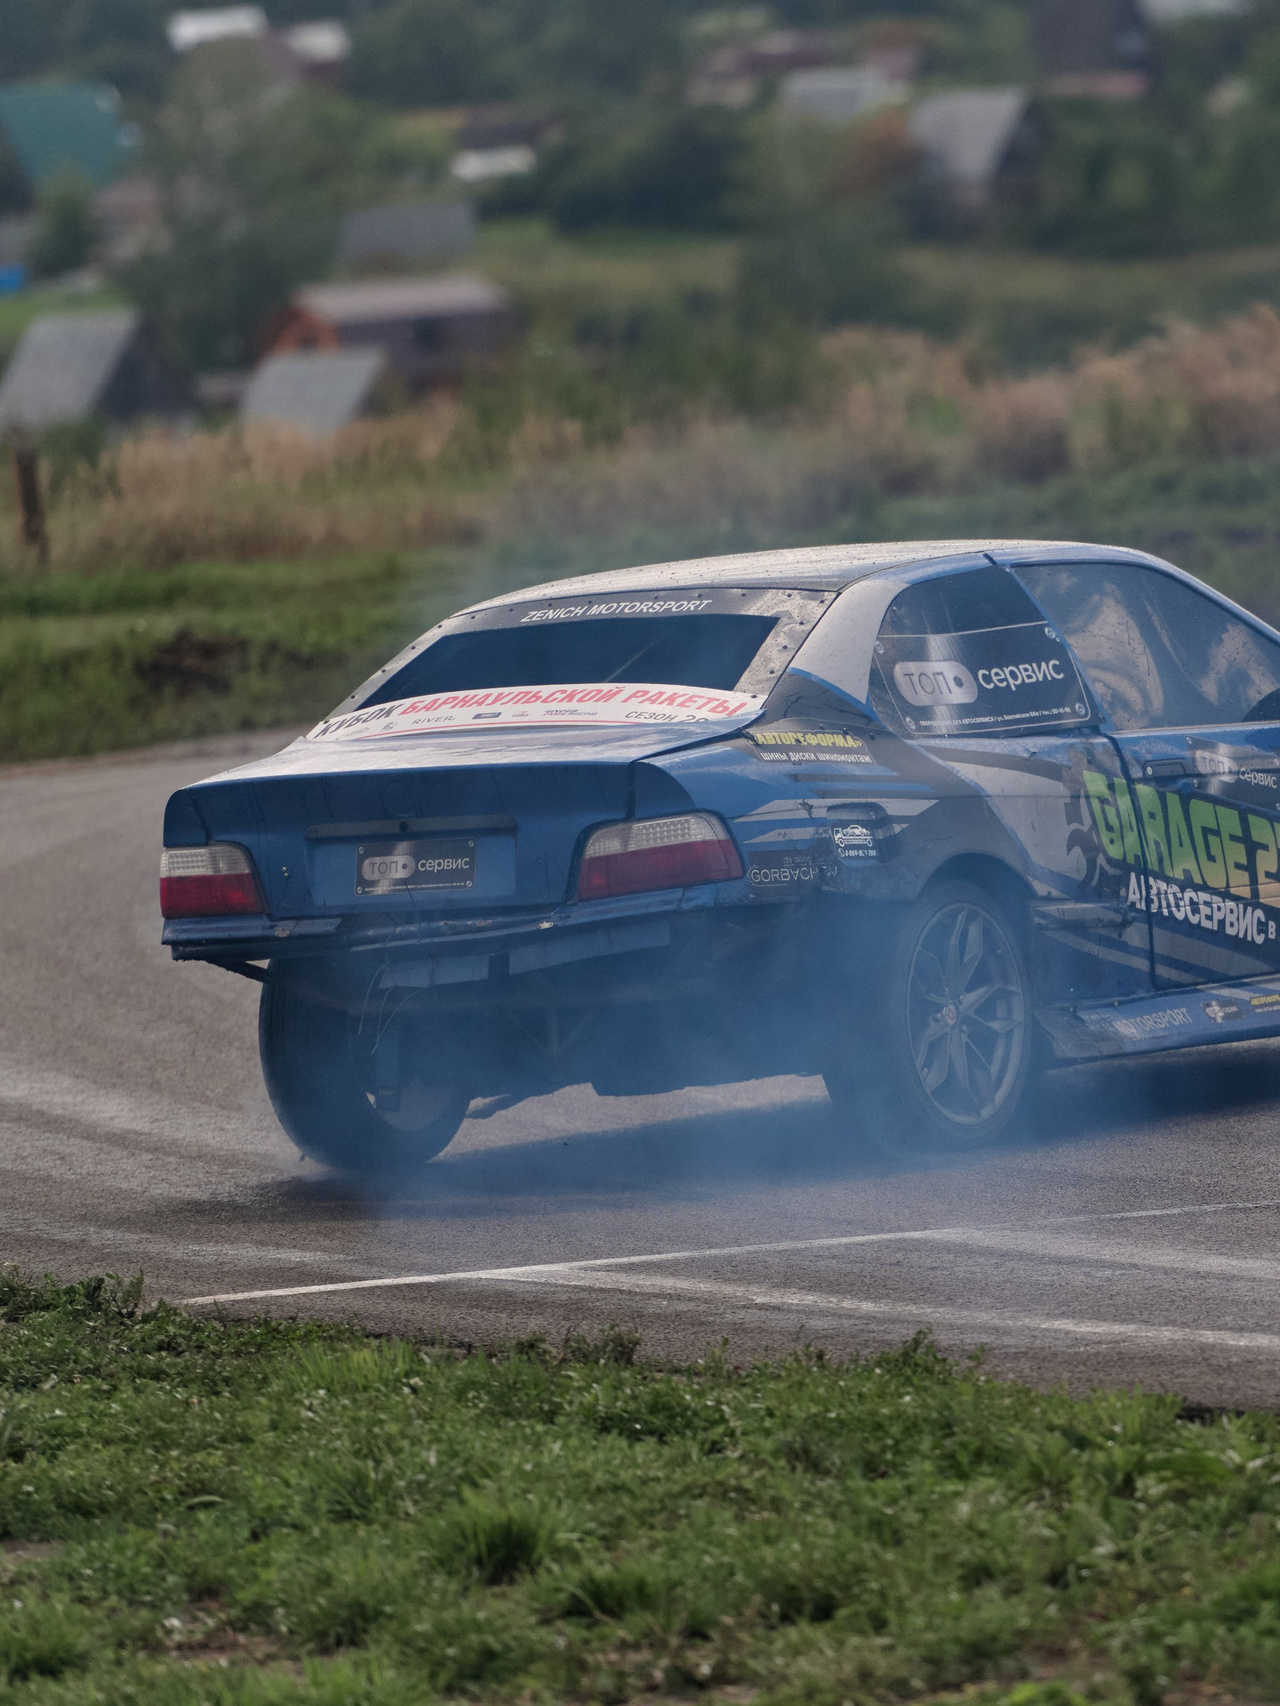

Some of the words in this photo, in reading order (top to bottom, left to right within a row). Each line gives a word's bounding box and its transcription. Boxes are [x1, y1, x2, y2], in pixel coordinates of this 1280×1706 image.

[520, 605, 588, 623] ZENICH
[586, 599, 713, 616] MOTORSPORT
[903, 671, 953, 696] ТОП
[977, 659, 1065, 691] сервис
[314, 703, 404, 739] КУБОК
[398, 686, 626, 716] БАРНАУЛЬСКОЙ
[620, 689, 748, 717] РАКЕТЫ
[411, 715, 456, 725] RIVER
[625, 711, 676, 723] СЕЗОН
[1201, 756, 1225, 774] ТОП
[1239, 768, 1277, 789] сервис
[1083, 770, 1252, 899] GARAGE
[369, 861, 398, 875] ТОП
[418, 858, 470, 872] сервис
[1267, 919, 1276, 939] в
[1112, 1007, 1193, 1034] MOTORSPORT
